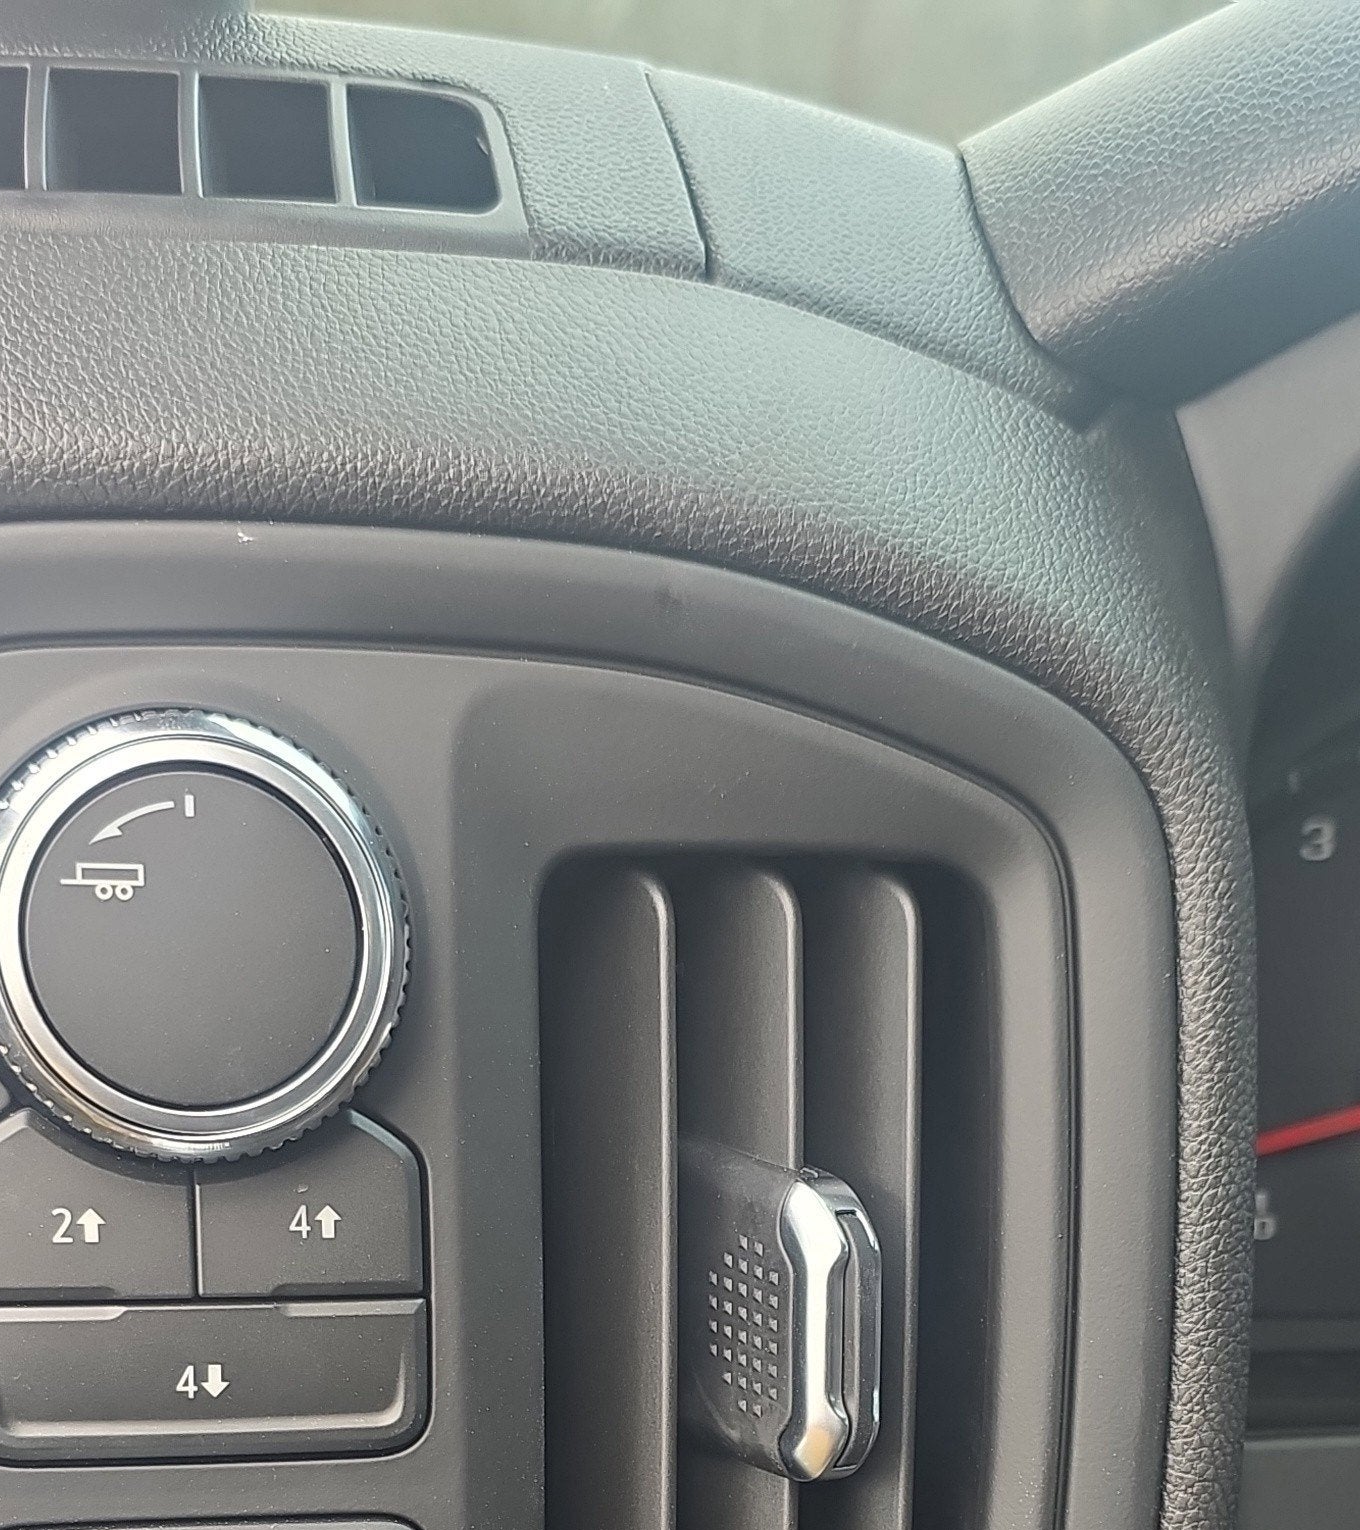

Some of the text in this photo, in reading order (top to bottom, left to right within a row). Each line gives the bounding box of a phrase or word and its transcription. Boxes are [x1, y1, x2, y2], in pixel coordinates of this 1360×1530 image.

[1299, 818, 1337, 861] 3
[51, 1207, 75, 1243] 2
[289, 1205, 311, 1239] 4
[176, 1365, 199, 1399] 4
